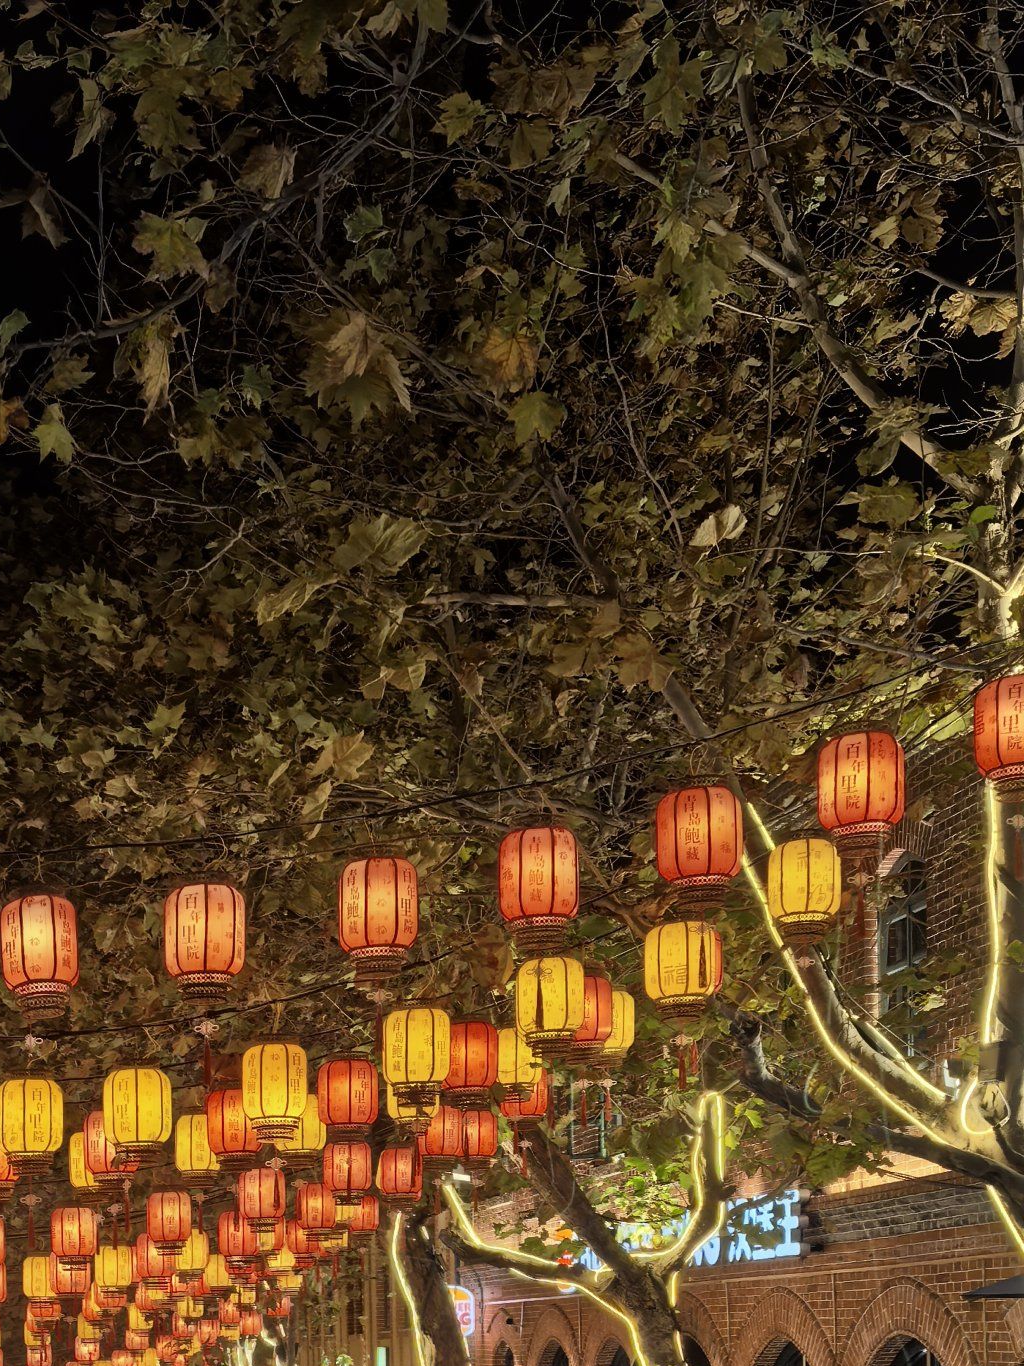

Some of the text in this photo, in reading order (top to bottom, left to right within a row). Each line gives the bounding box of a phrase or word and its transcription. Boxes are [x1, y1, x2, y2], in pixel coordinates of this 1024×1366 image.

[842, 742, 864, 809] 百年里院
[182, 893, 202, 961] 百年里院
[400, 868, 416, 934] 百年里院
[3, 909, 20, 975] 百年里院
[29, 1088, 47, 1143] 百年里院
[354, 1067, 370, 1116] 百年里院
